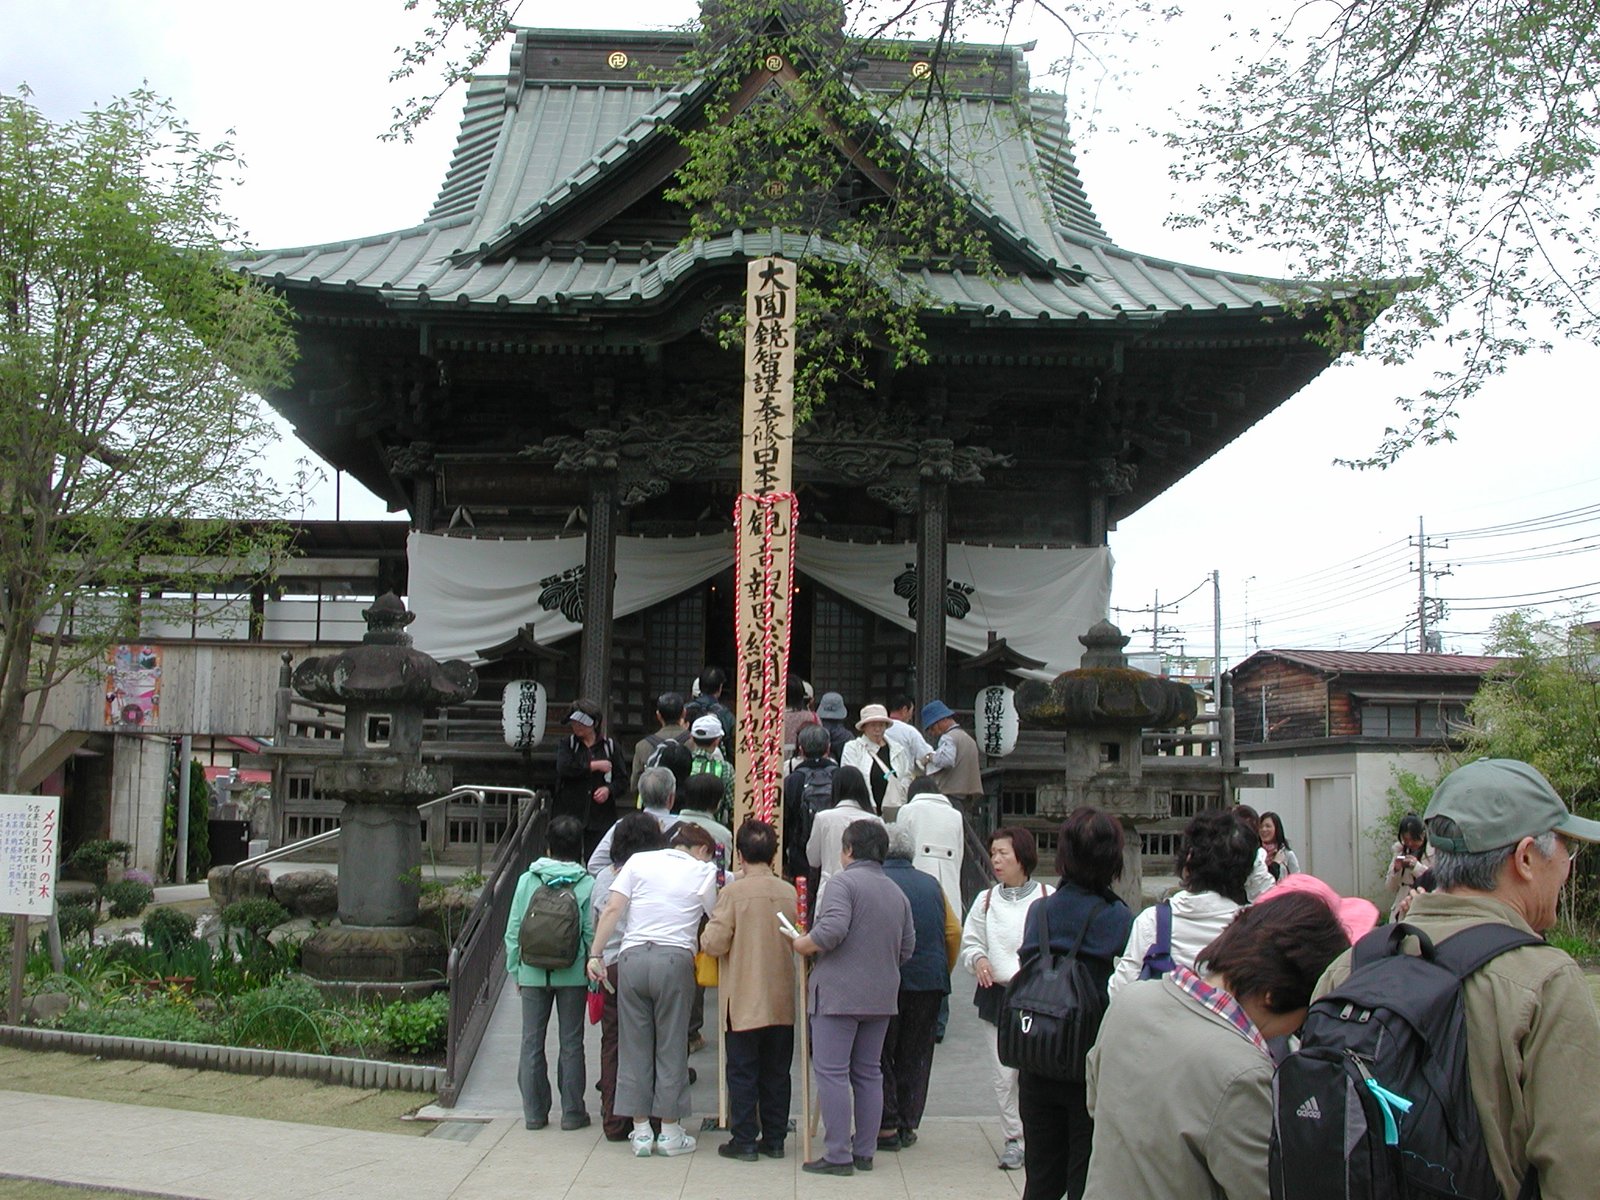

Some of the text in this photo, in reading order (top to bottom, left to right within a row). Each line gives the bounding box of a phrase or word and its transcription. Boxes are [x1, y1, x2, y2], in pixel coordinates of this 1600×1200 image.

[38, 809, 55, 898] メグスリの木
[1296, 1109, 1321, 1119] adidas
